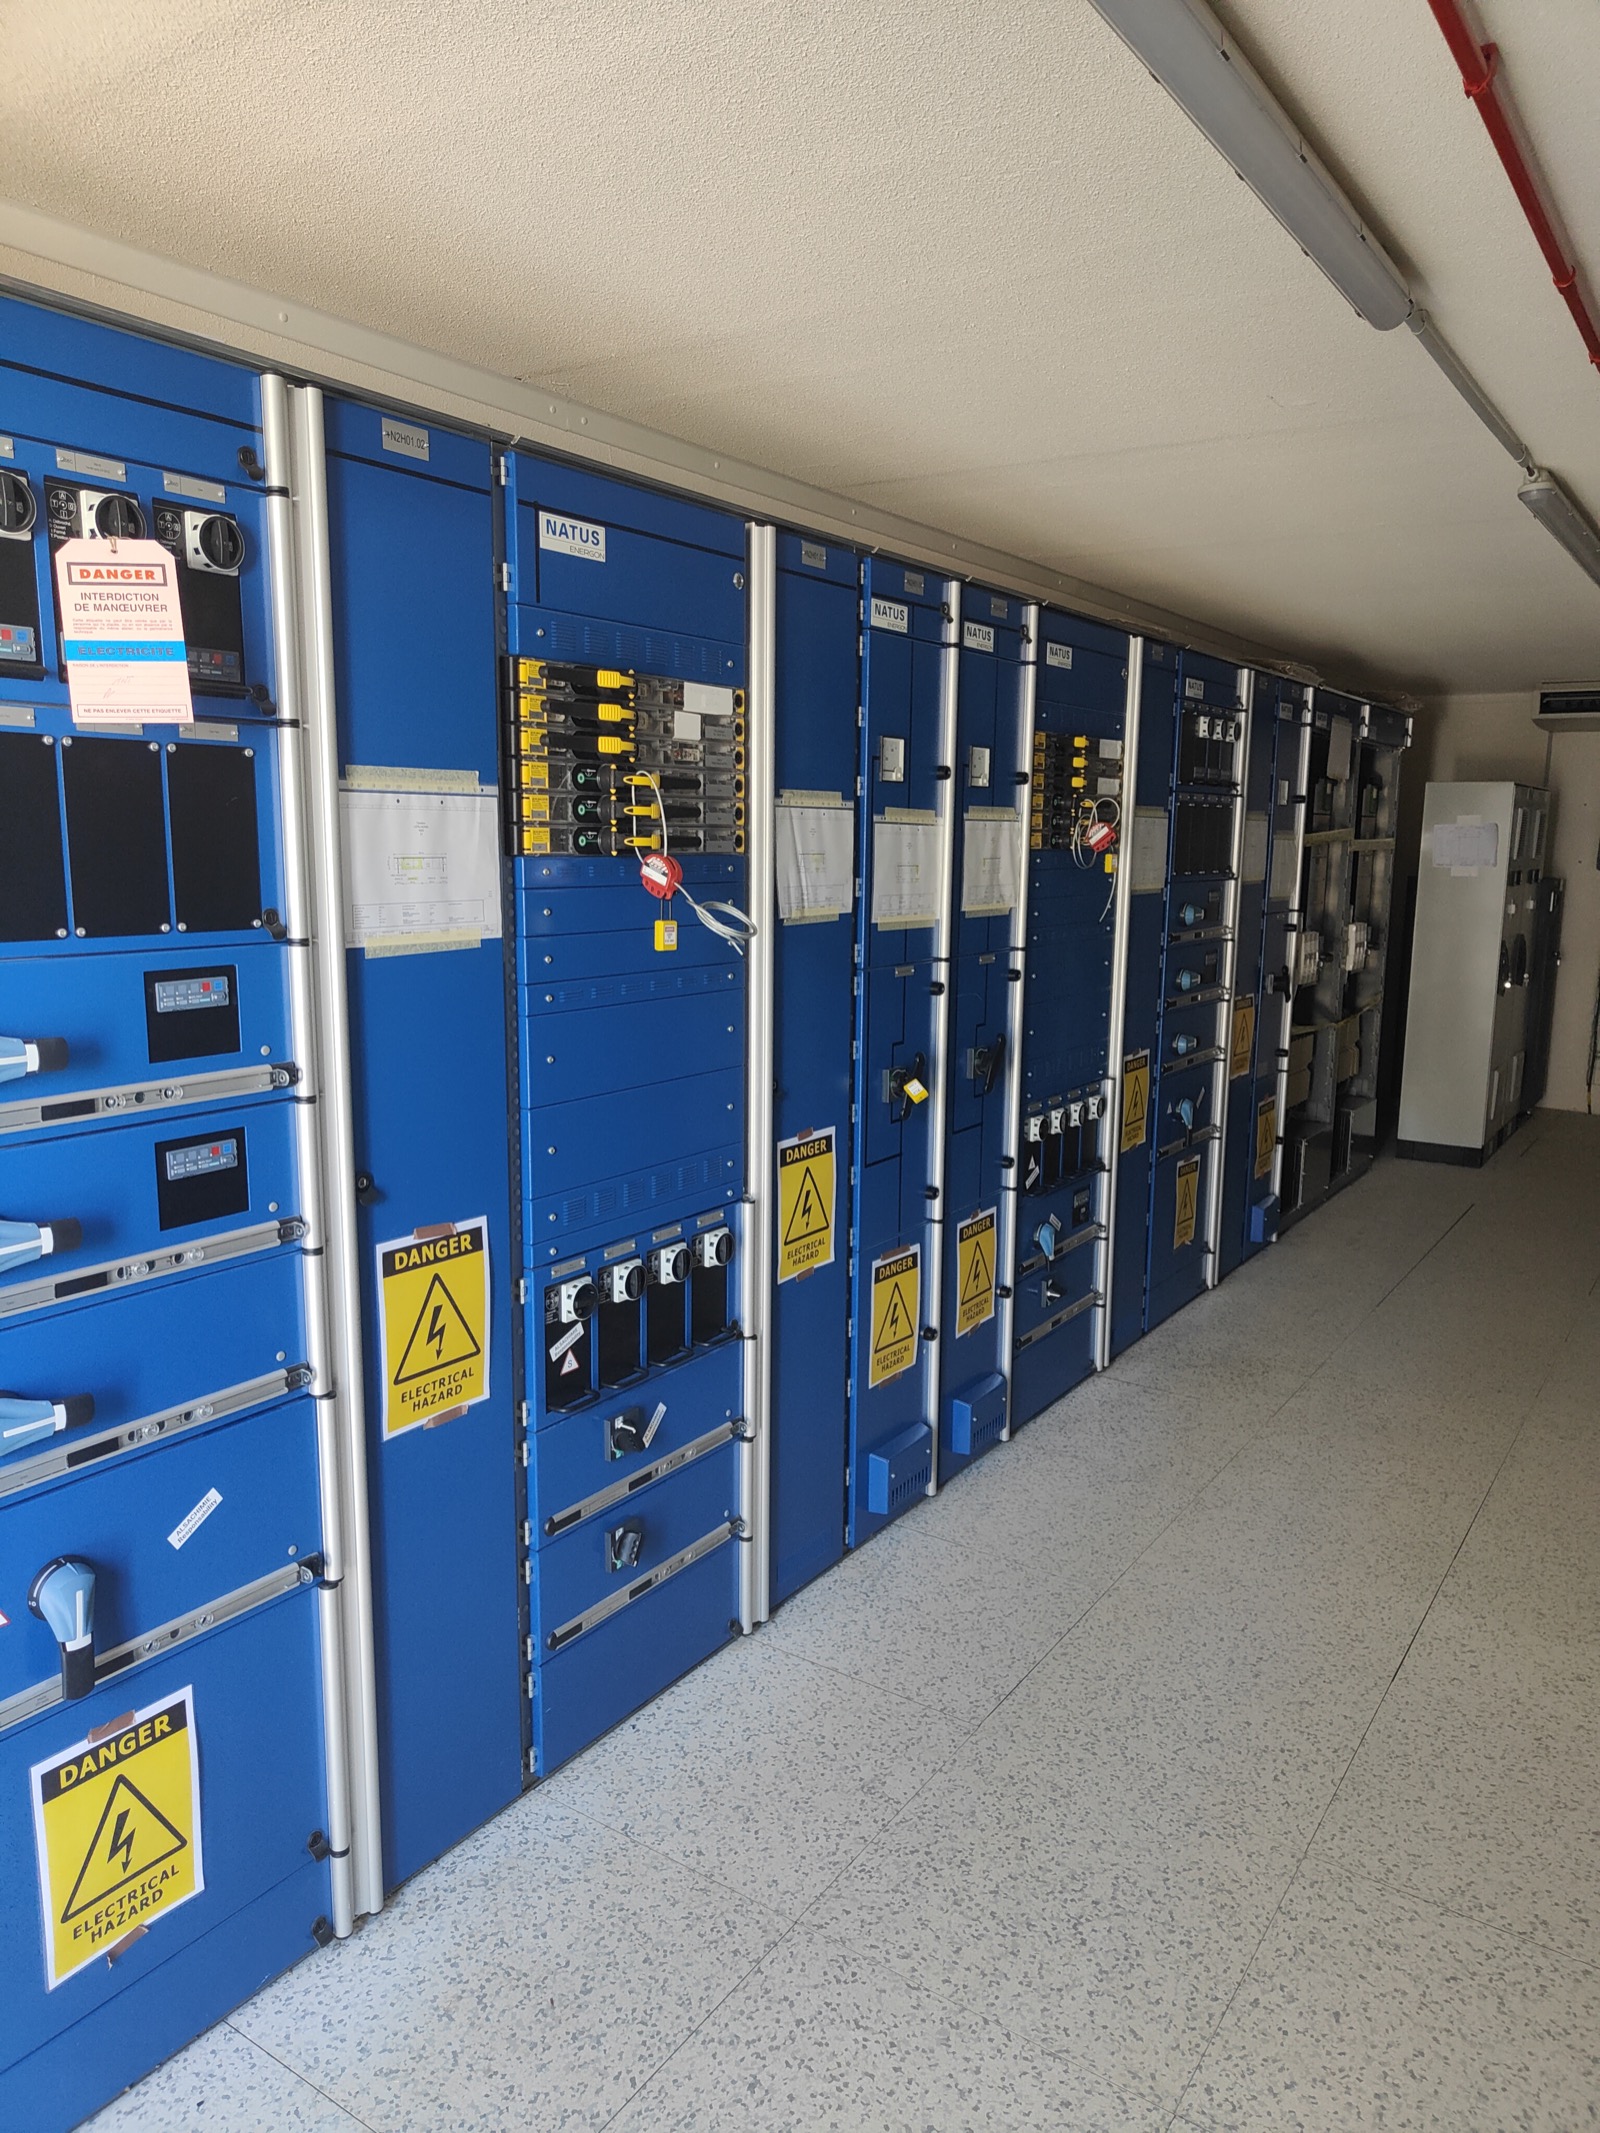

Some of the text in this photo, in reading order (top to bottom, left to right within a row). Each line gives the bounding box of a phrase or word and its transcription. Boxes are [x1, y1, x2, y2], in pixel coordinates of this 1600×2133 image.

[545, 518, 600, 546] NATUS
[569, 545, 605, 561] ENERGON
[79, 568, 156, 580] DANGER
[74, 603, 168, 612] DE MANŒUVRER
[80, 592, 160, 602] INTERDICTION
[874, 602, 905, 622] NATUS
[966, 625, 992, 641] NATUS
[77, 647, 175, 656] ELECTRICITE
[1049, 646, 1071, 660] NATUS
[786, 1139, 827, 1163] DANGER
[962, 1217, 991, 1240] DANGER
[394, 1233, 473, 1271] DANGER
[787, 1237, 826, 1260] ELECTRICAL
[792, 1249, 820, 1267] HAZARD
[879, 1256, 914, 1280] DANGER
[962, 1297, 989, 1318] ELECTRICAL
[567, 1359, 573, 1369] S
[876, 1344, 910, 1367] ELECTRICAL
[881, 1356, 905, 1373] HAZARD
[401, 1366, 475, 1404] ELECTRICAL
[412, 1384, 463, 1413] HAZARD
[176, 1496, 212, 1537] ALSACHIMIE
[177, 1499, 218, 1544] Responsability
[59, 1713, 173, 1791] DANGER
[73, 1864, 180, 1941] ELECTRICAL
[90, 1888, 164, 1944] HAZARD
